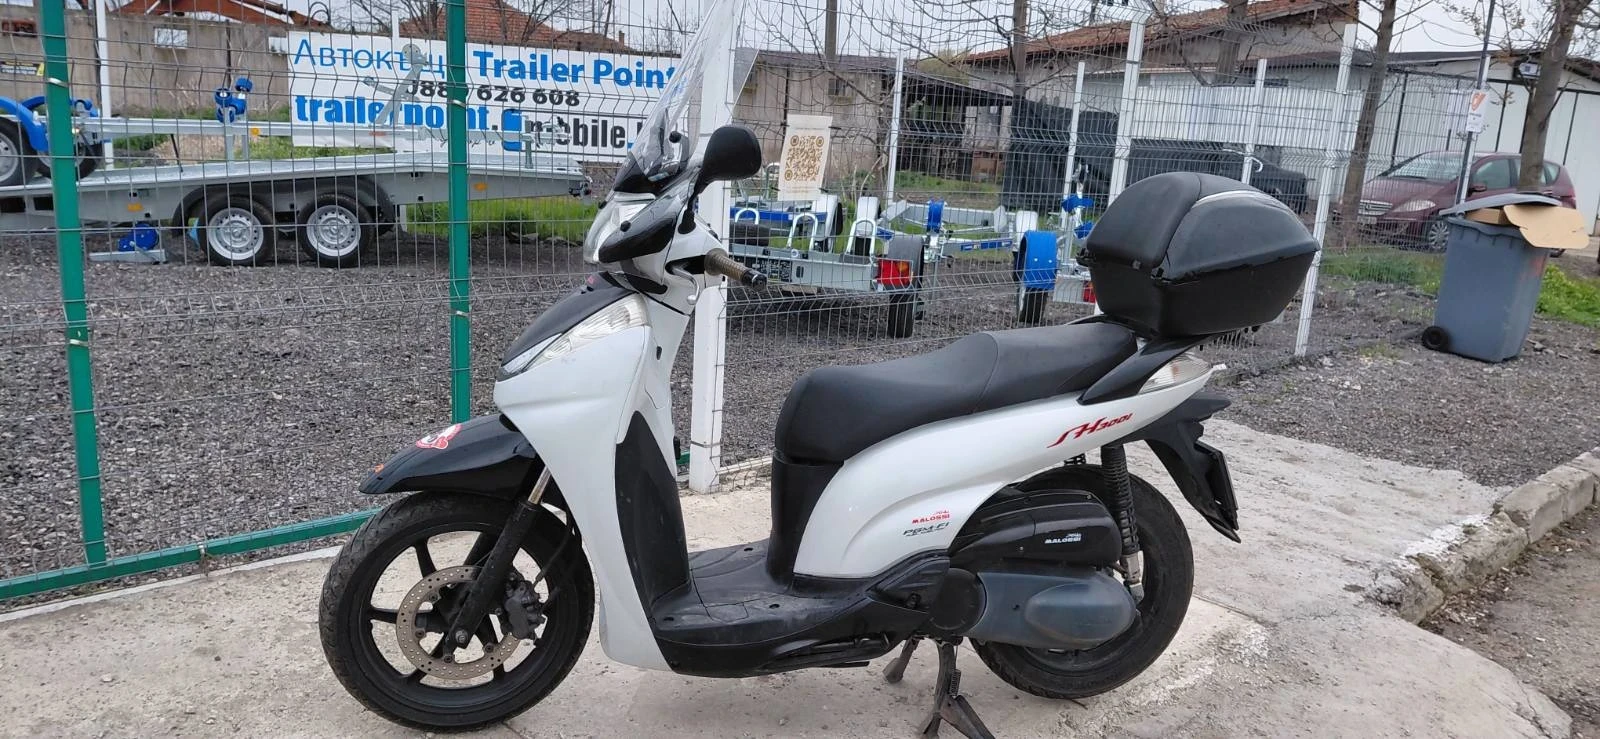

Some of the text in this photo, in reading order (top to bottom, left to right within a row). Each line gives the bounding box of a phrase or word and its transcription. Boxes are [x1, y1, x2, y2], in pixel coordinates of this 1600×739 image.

[294, 39, 446, 79] Автокъщ
[473, 50, 585, 83] Trailer
[406, 80, 580, 107] 088 626 608
[912, 513, 950, 524] MALOSSI
